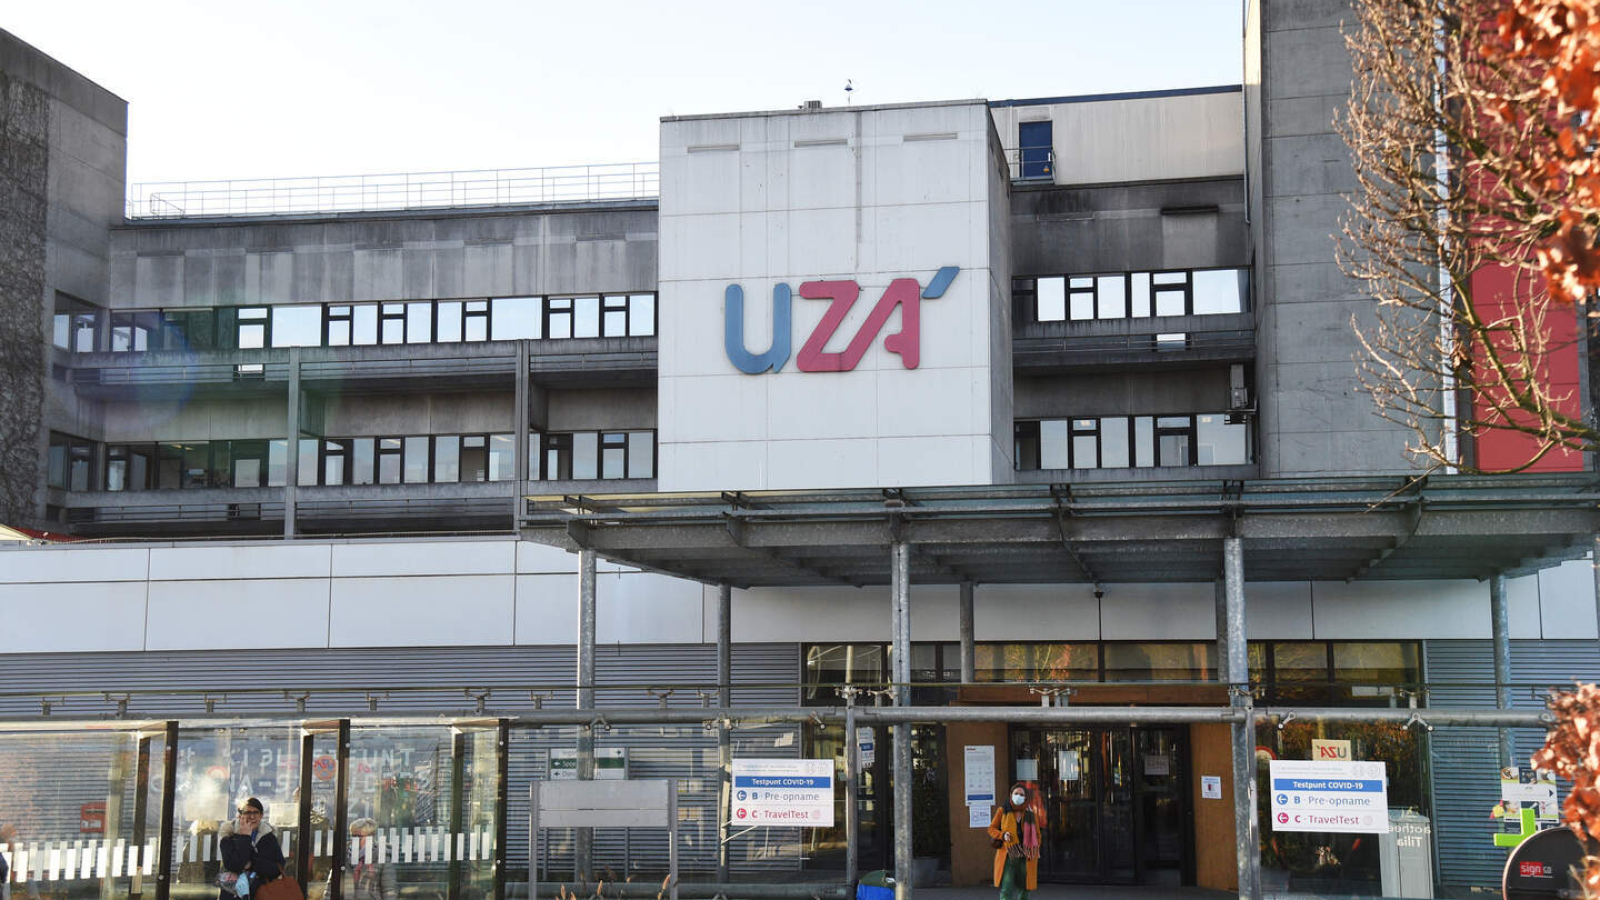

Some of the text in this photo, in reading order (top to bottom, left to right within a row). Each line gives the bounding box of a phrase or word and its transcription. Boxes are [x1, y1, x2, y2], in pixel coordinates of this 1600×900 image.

[751, 778, 814, 787] Testpunt COVID-19
[1292, 781, 1363, 790] Testpunt COVID-19
[752, 792, 758, 800] B
[1293, 796, 1301, 804] B
[751, 810, 809, 818] C TravelTest
[1294, 814, 1360, 825] C TravelTest
[1520, 862, 1541, 876] sign
